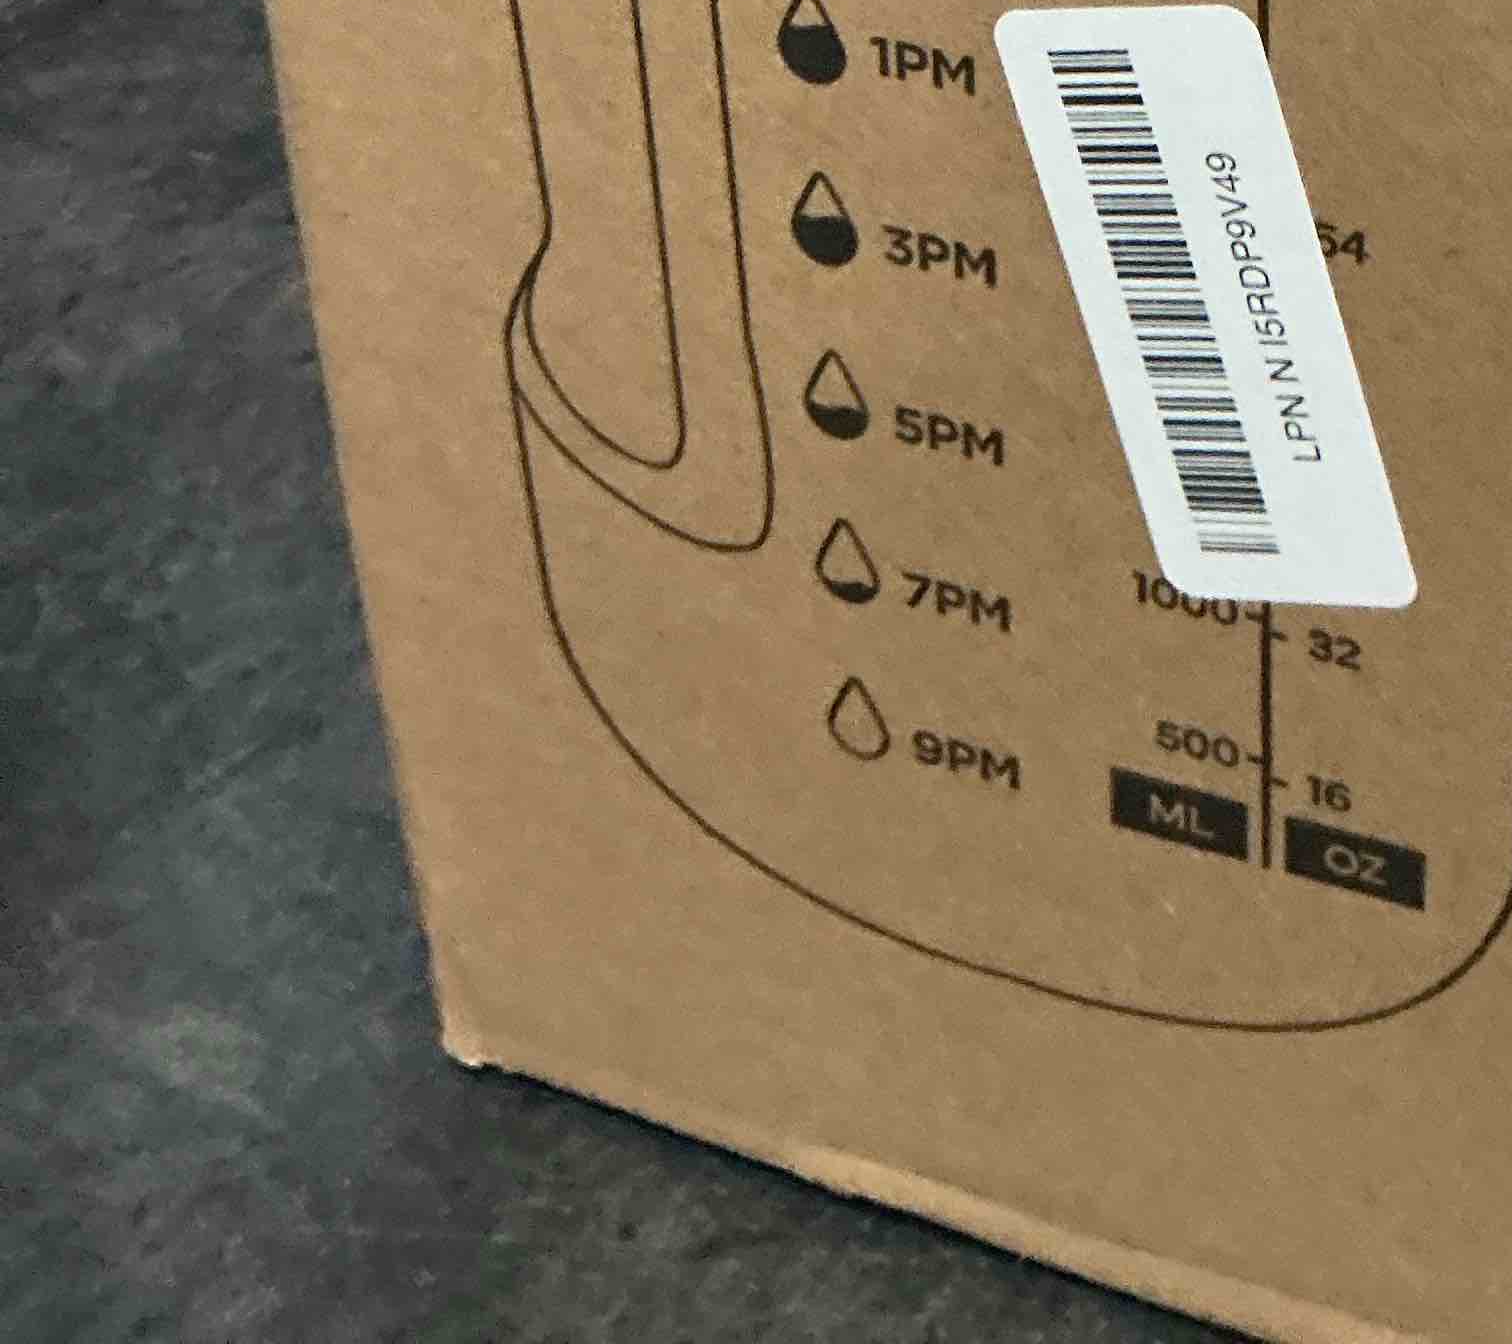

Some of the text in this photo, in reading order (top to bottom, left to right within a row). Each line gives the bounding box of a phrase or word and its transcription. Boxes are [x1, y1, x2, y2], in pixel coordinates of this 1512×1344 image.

[870, 36, 976, 97] 1PM
[883, 225, 997, 289] 3PM
[895, 406, 1004, 467] 5PM
[902, 571, 1012, 633] 7PM
[1308, 629, 1361, 671] 32
[912, 730, 1021, 790] 9PM
[1156, 719, 1240, 768] 500
[1147, 793, 1215, 839] ML
[1307, 775, 1351, 812] 16
[1323, 844, 1388, 885] OZ
